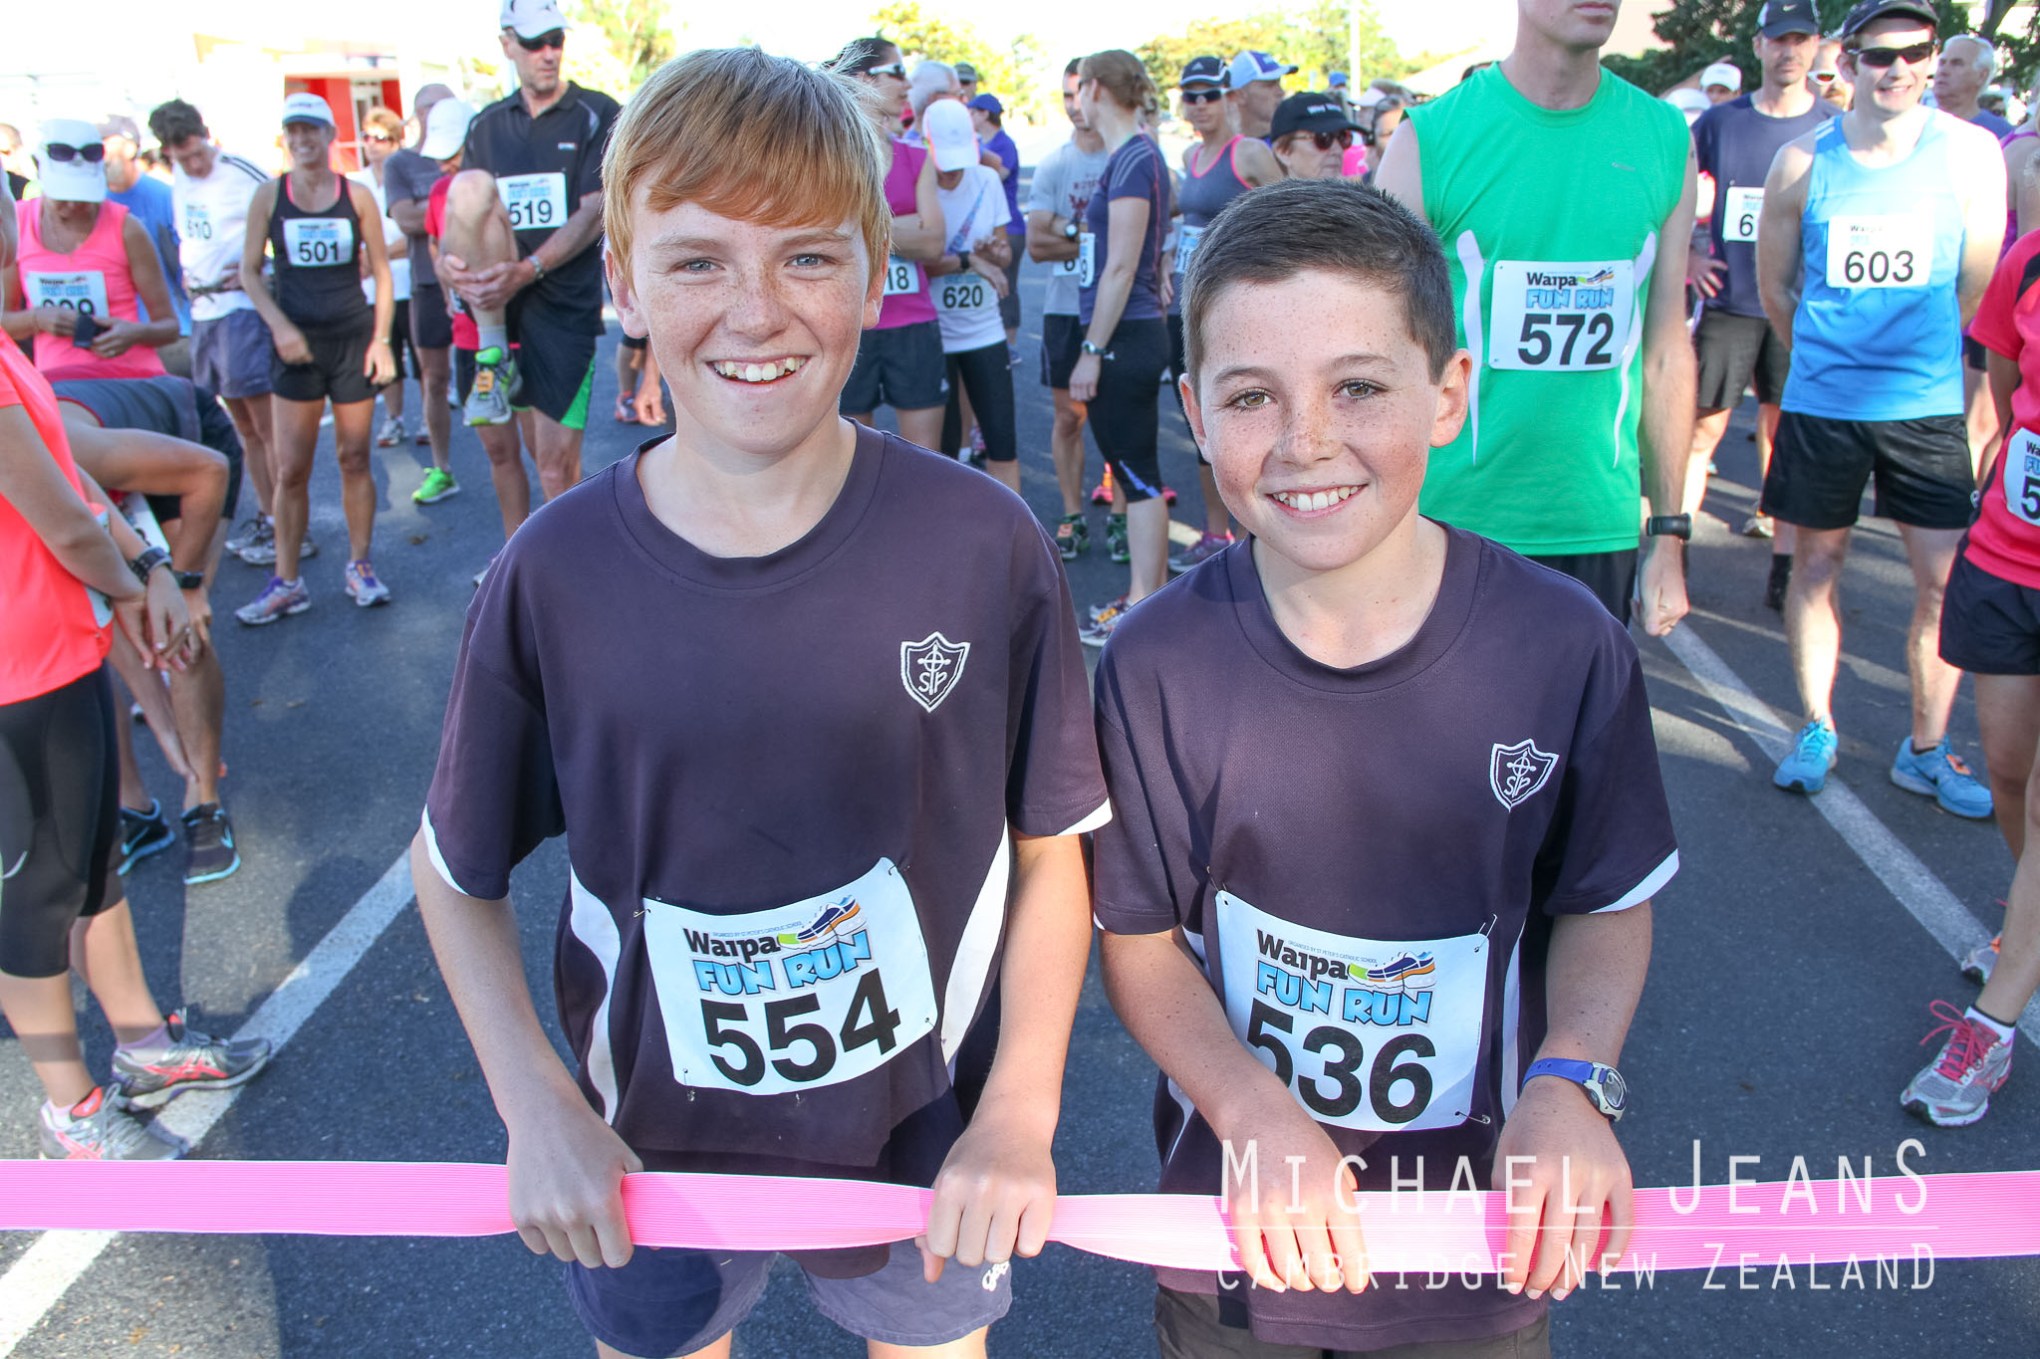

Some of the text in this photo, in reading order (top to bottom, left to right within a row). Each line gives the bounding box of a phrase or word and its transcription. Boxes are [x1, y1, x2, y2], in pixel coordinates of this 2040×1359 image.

[508, 199, 553, 226] 519
[300, 241, 340, 262] 501
[1844, 250, 1915, 284] 603
[942, 284, 984, 309] 620
[1526, 272, 1578, 290] Waipa
[1526, 287, 1615, 310] FUN RUN
[1518, 312, 1614, 366] 572
[2020, 475, 2040, 520] 5
[683, 927, 781, 964] Waipa
[692, 959, 776, 996] FUN
[782, 928, 872, 989] RUN
[1256, 928, 1349, 981] Waipa
[1257, 960, 1434, 1027] FUN RUN
[700, 967, 901, 1087] 554
[1246, 997, 1437, 1125] 536
